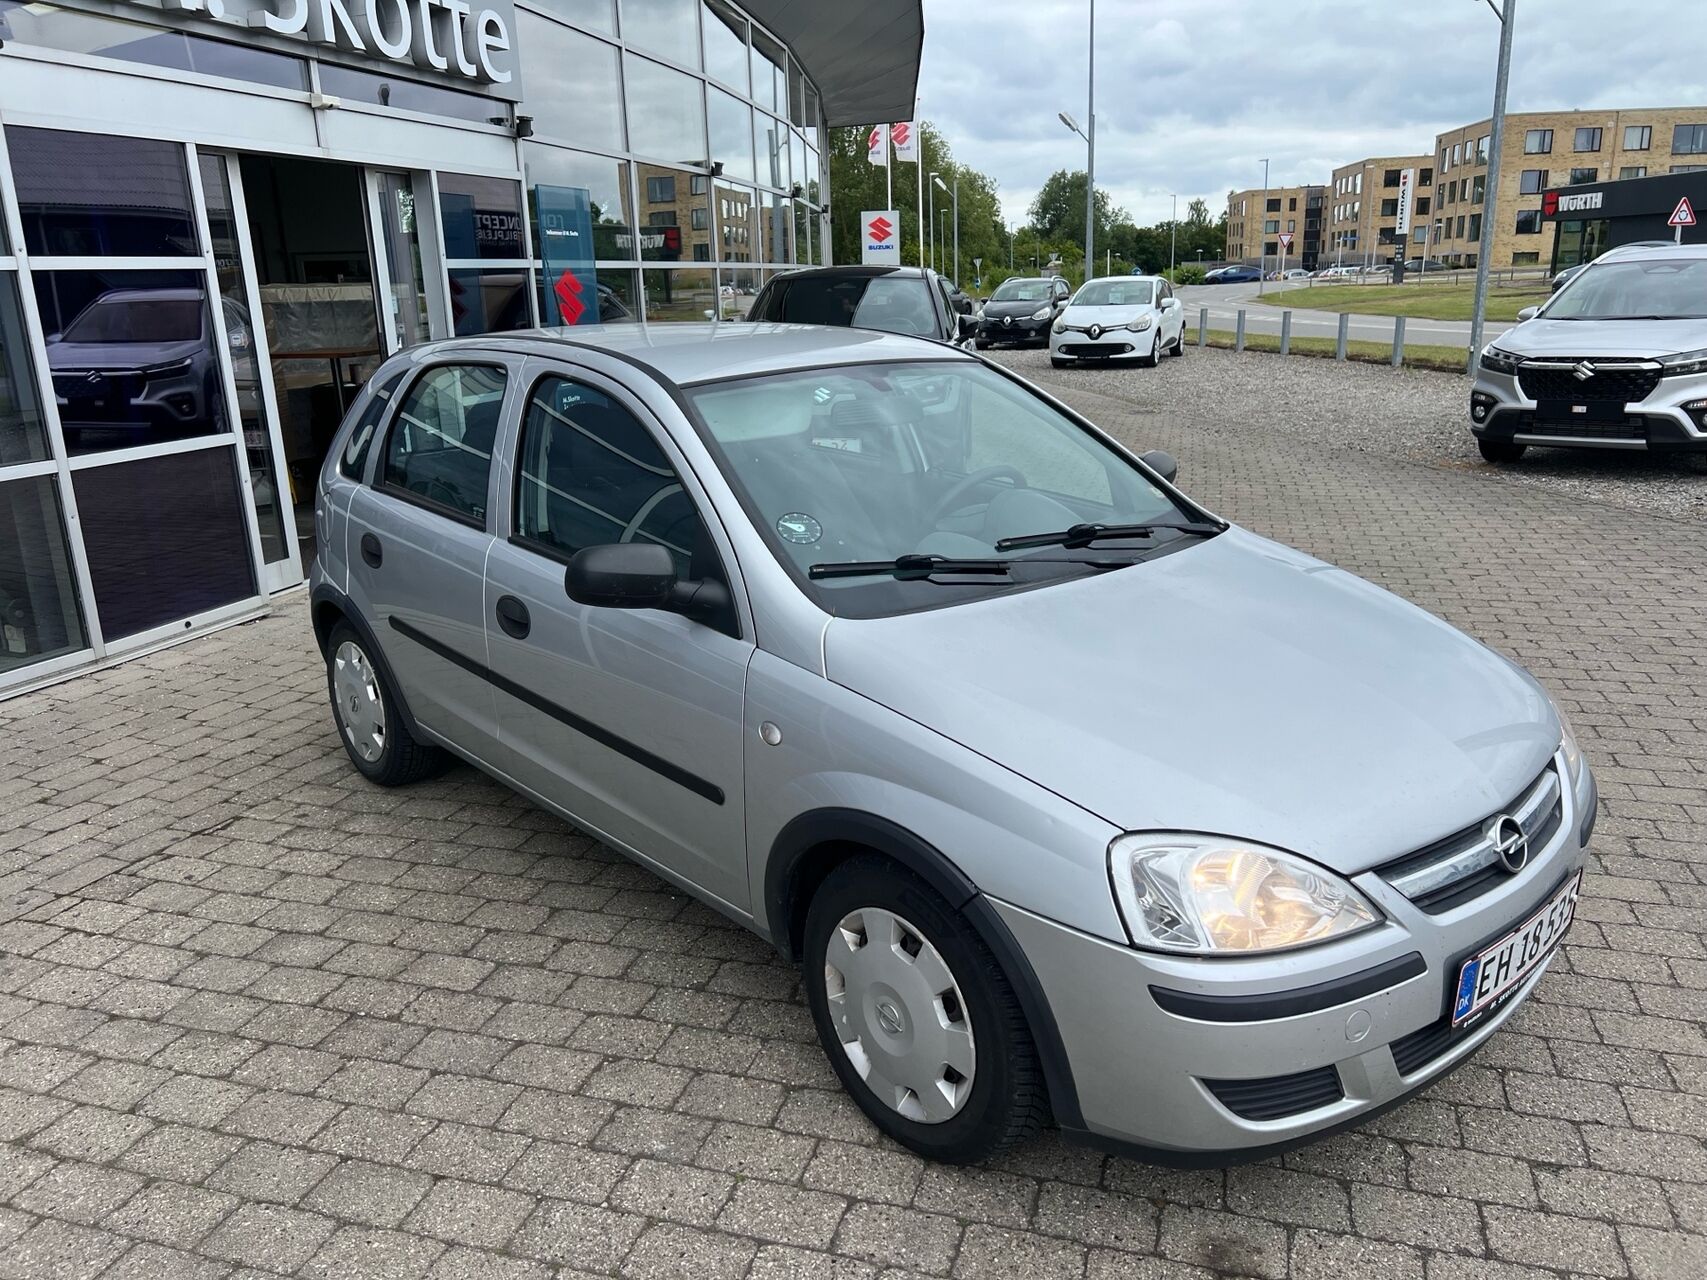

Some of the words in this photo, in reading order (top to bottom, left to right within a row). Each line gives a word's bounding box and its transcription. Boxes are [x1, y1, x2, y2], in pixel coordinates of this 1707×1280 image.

[1558, 192, 1603, 211] WÜRTH
[1477, 943, 1515, 1000] EH
[1516, 919, 1544, 972] 18
[1458, 994, 1471, 1011] DK
